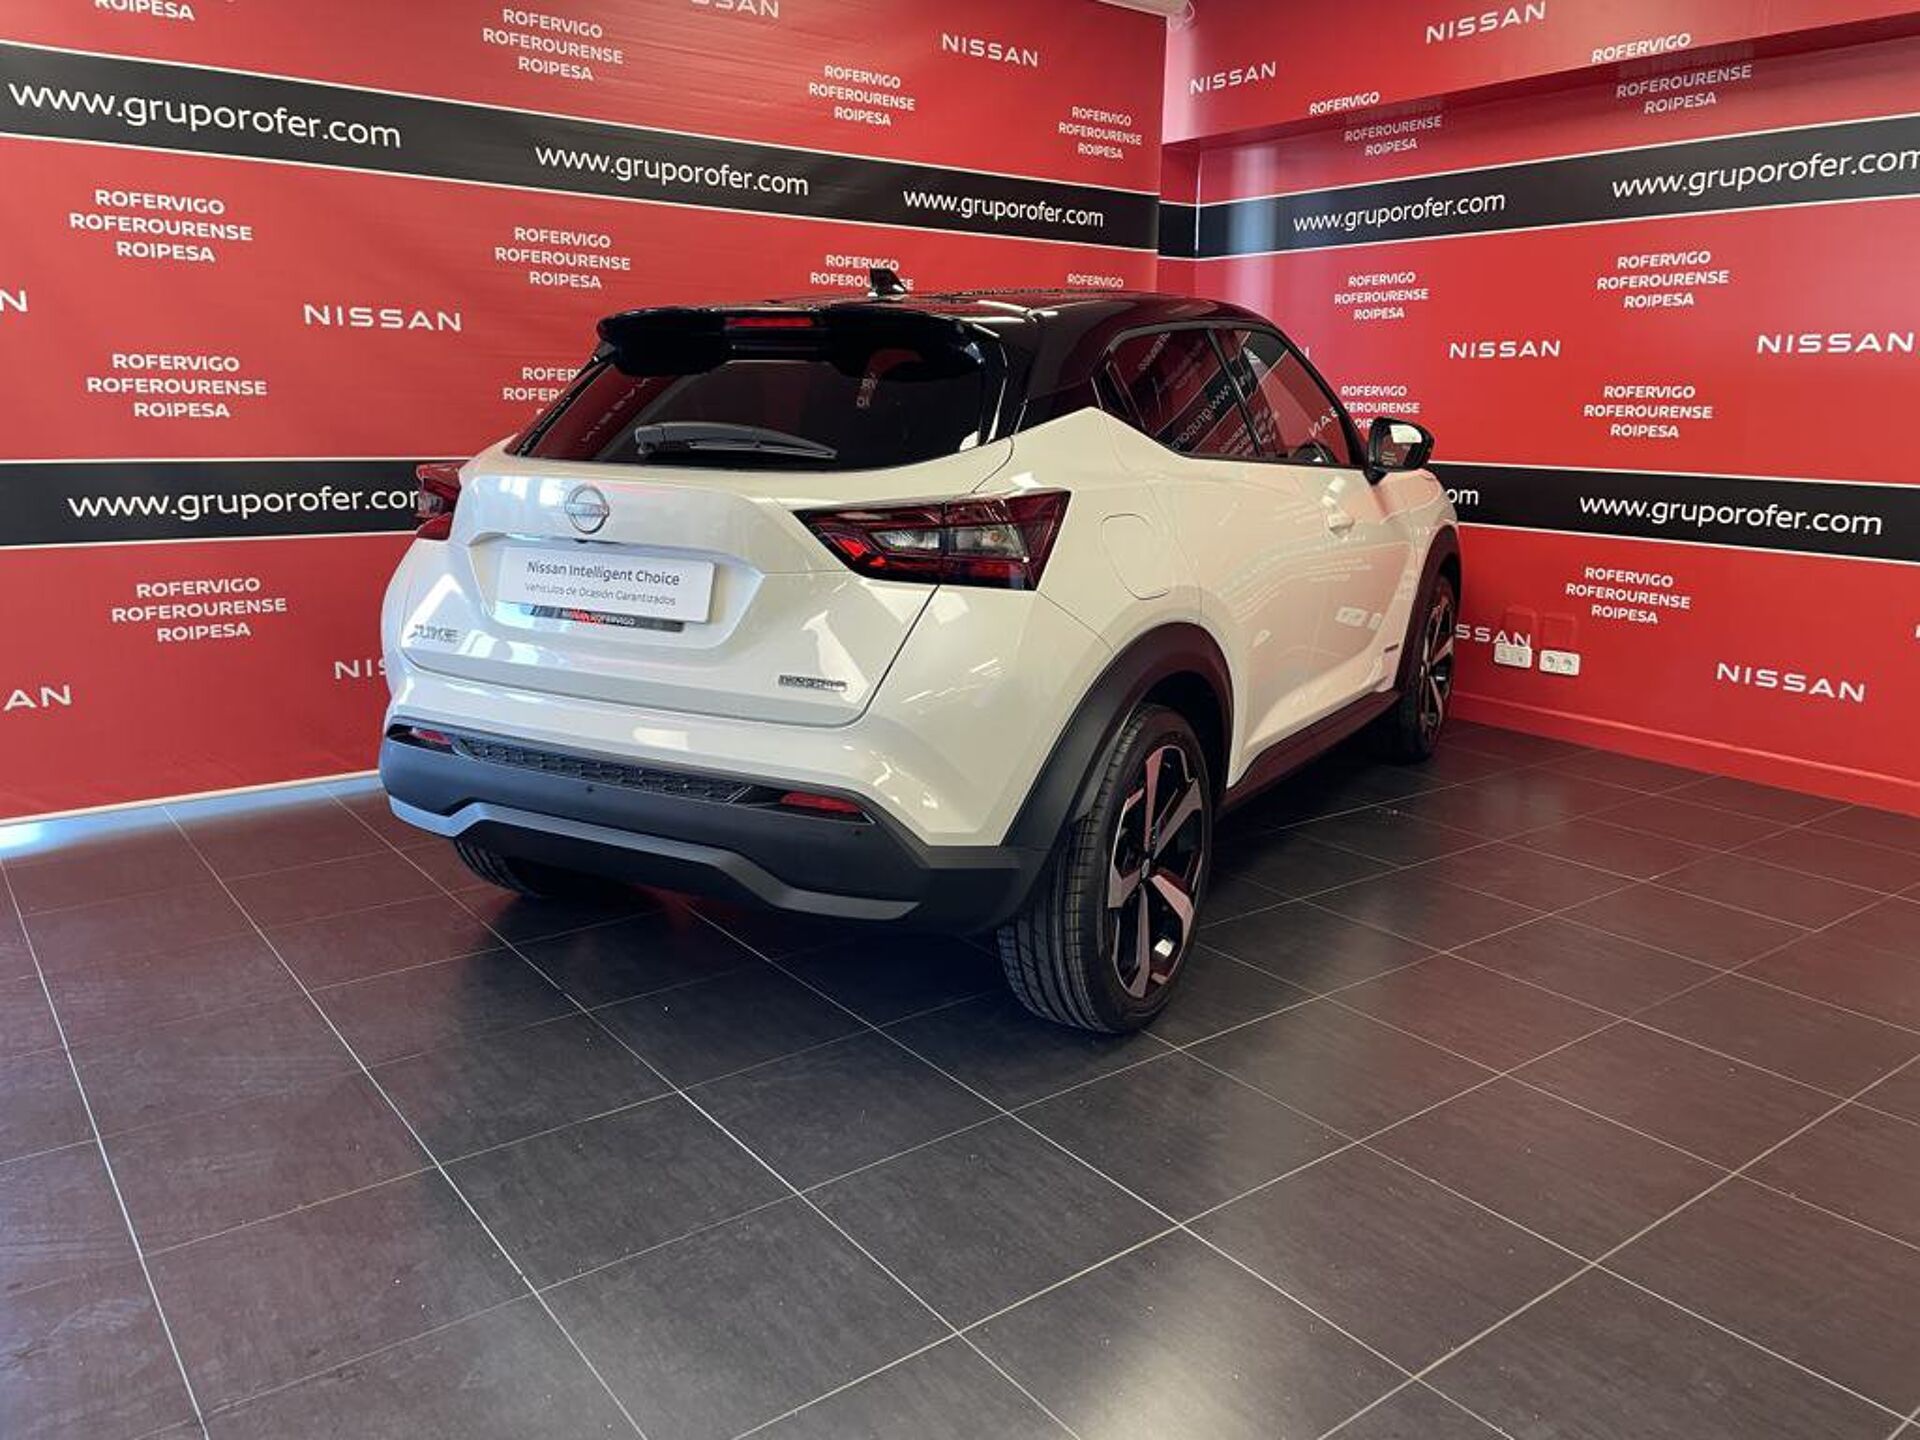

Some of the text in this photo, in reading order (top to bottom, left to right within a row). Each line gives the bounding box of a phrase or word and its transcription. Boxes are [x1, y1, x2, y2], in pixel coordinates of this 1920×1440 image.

[503, 9, 604, 38] ROFERVIGO
[1426, 1, 1546, 43] NISSAN
[483, 28, 624, 65] ROFEROURENSE
[942, 33, 1039, 67] NISSAN
[1591, 33, 1692, 63] ROFERVIGO
[518, 56, 594, 81] ROIPESA
[824, 65, 901, 89] ROFERVIGO
[1189, 61, 1277, 95] NISSAN
[1616, 64, 1753, 98] ROFEROURENSE
[809, 82, 916, 111] ROFEROURENSE
[1308, 91, 1381, 116] ROFERVIGO
[1644, 91, 1717, 115] ROIPESA
[9, 83, 402, 148] www.gruporofer.com
[834, 106, 892, 126] ROIPESA
[1072, 106, 1132, 127] ROFERVIGO
[1058, 122, 1143, 145] ROFEROURENSE
[1344, 115, 1443, 142] ROFEROURENSE
[1078, 142, 1124, 160] ROIPESA
[1365, 138, 1418, 157] ROIPESA
[535, 147, 810, 195] www.gruporofer.com
[95, 189, 225, 215] ROFERVIGO
[903, 190, 1104, 227] www.gruporofer.com
[1293, 194, 1506, 233] www.gruporofer.com
[69, 213, 253, 241] ROFEROURENSE
[514, 227, 611, 248] ROFERVIGO
[116, 241, 216, 263] ROIPESA
[495, 247, 631, 271] ROFEROURENSE
[1617, 251, 1711, 270] ROFERVIGO
[530, 271, 602, 289] ROIPESA
[1067, 273, 1124, 288] ROFERVIGO
[1348, 272, 1416, 287] ROFERVIGO
[1597, 270, 1730, 290] ROFEROURENSE
[1334, 288, 1429, 304] ROFEROURENSE
[1623, 291, 1695, 309] ROIPESA
[303, 303, 462, 331] NISSAN
[1353, 307, 1405, 322] ROIPESA
[1449, 340, 1561, 359] NISSAN
[1757, 331, 1915, 353] NISSAN
[113, 353, 240, 372] ROFERVIGO
[522, 366, 581, 382] ROFER
[87, 377, 268, 396] ROFEROURENSE
[1341, 385, 1408, 397] ROFERVIGO
[1603, 385, 1696, 400] ROFERVIGO
[134, 402, 230, 419] ROIPESA
[1584, 404, 1713, 420] ROFEROURENSE
[1610, 423, 1680, 439] ROIPESA
[1579, 496, 1883, 535] www.gruporofer.com
[527, 561, 681, 587] Nissan Intelligent Choice
[1584, 567, 1674, 588] ROFERVIGO
[136, 577, 261, 598] ROFERVIGO
[1566, 583, 1692, 610] ROFEROURENSE
[112, 597, 287, 623] ROFEROURENSE
[1591, 605, 1659, 625] ROIPESA
[157, 622, 251, 643] ROIPESA
[1716, 662, 1866, 703] NISSAN
